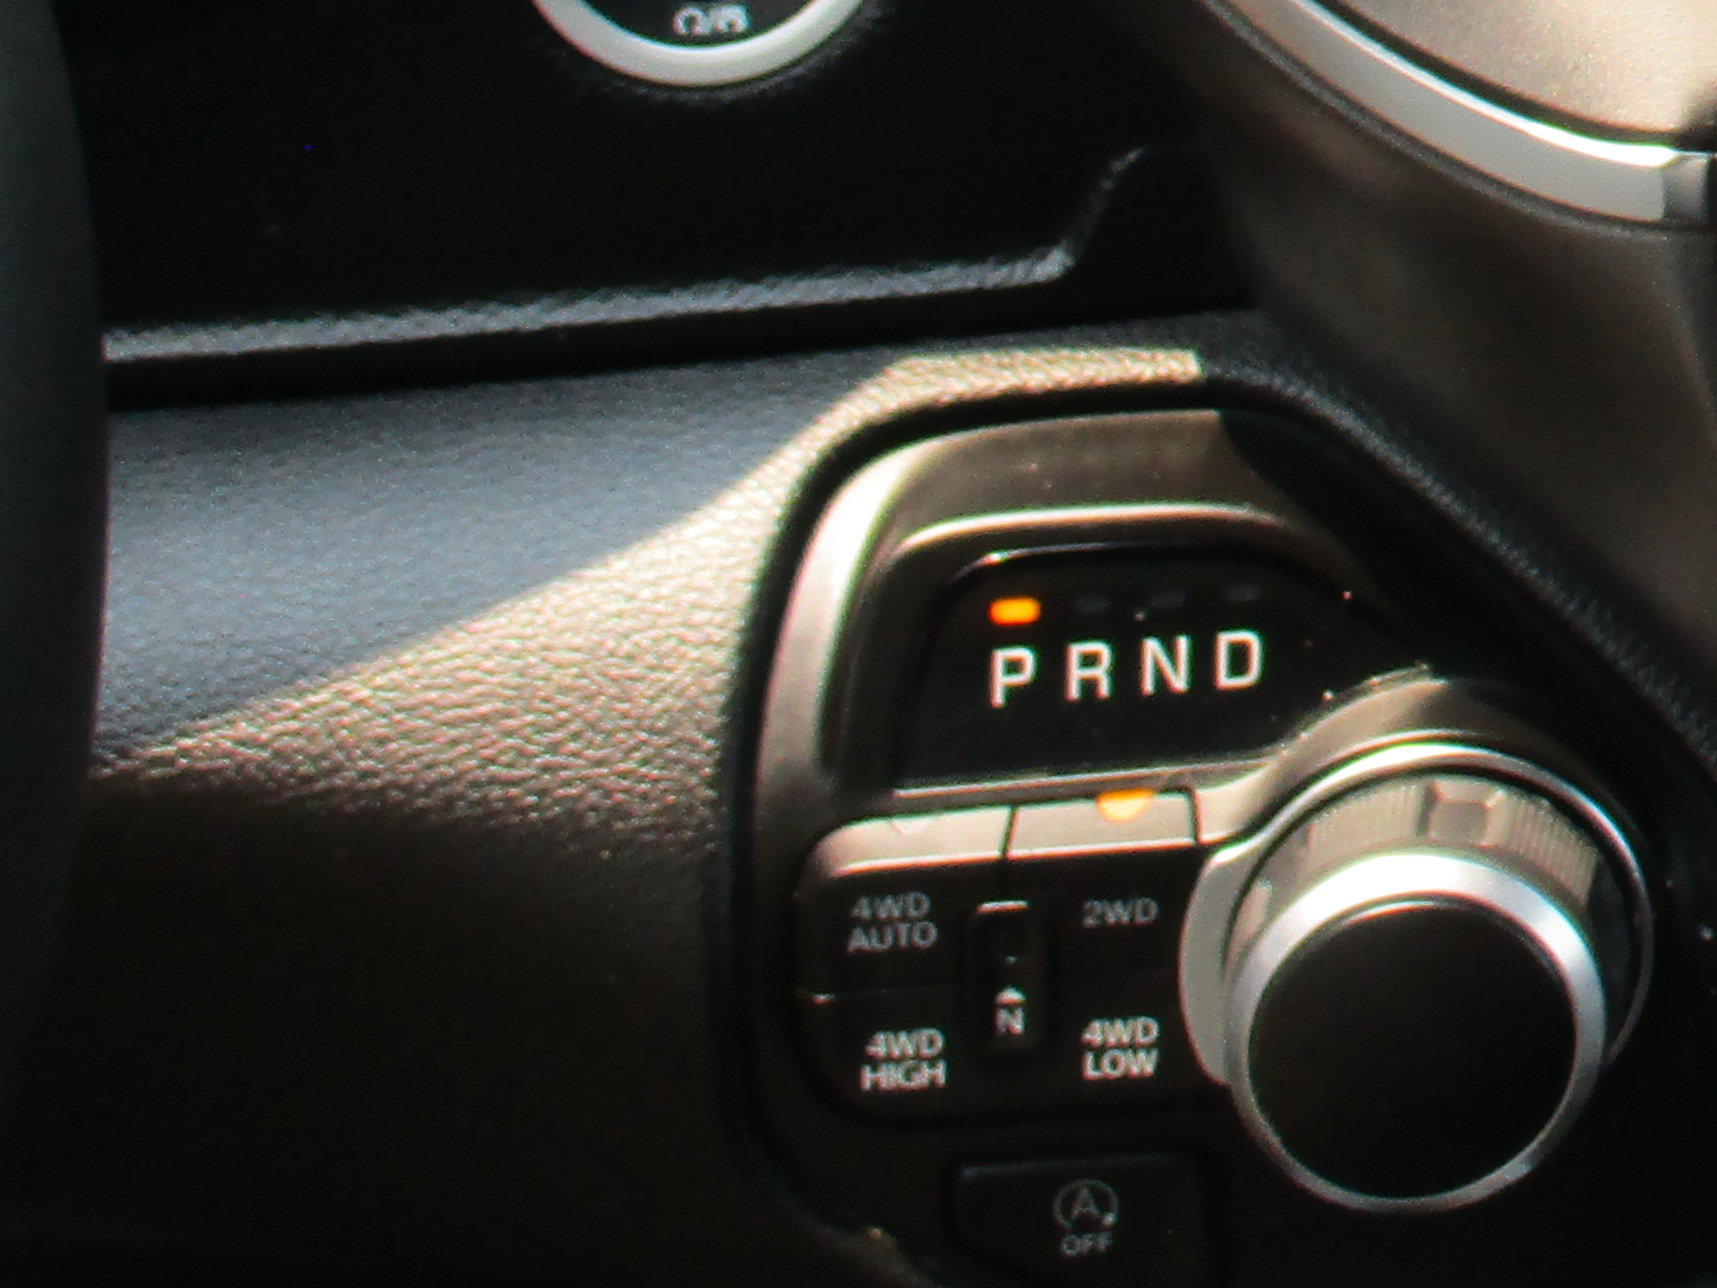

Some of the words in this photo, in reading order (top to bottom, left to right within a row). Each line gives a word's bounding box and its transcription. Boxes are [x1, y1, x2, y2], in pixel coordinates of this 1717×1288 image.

[990, 649, 1036, 707] P
[1066, 643, 1112, 699] R
[1140, 637, 1190, 694] N
[1216, 631, 1262, 689] D
[851, 892, 931, 922] 4WD
[1083, 898, 1157, 926] 2WD
[848, 921, 936, 952] AUTO
[866, 1028, 944, 1061] 4WD
[1083, 1016, 1158, 1049] 4WD
[861, 1058, 945, 1090] HIGH
[1083, 1048, 1157, 1079] LOW
[1062, 1232, 1112, 1256] OFF
